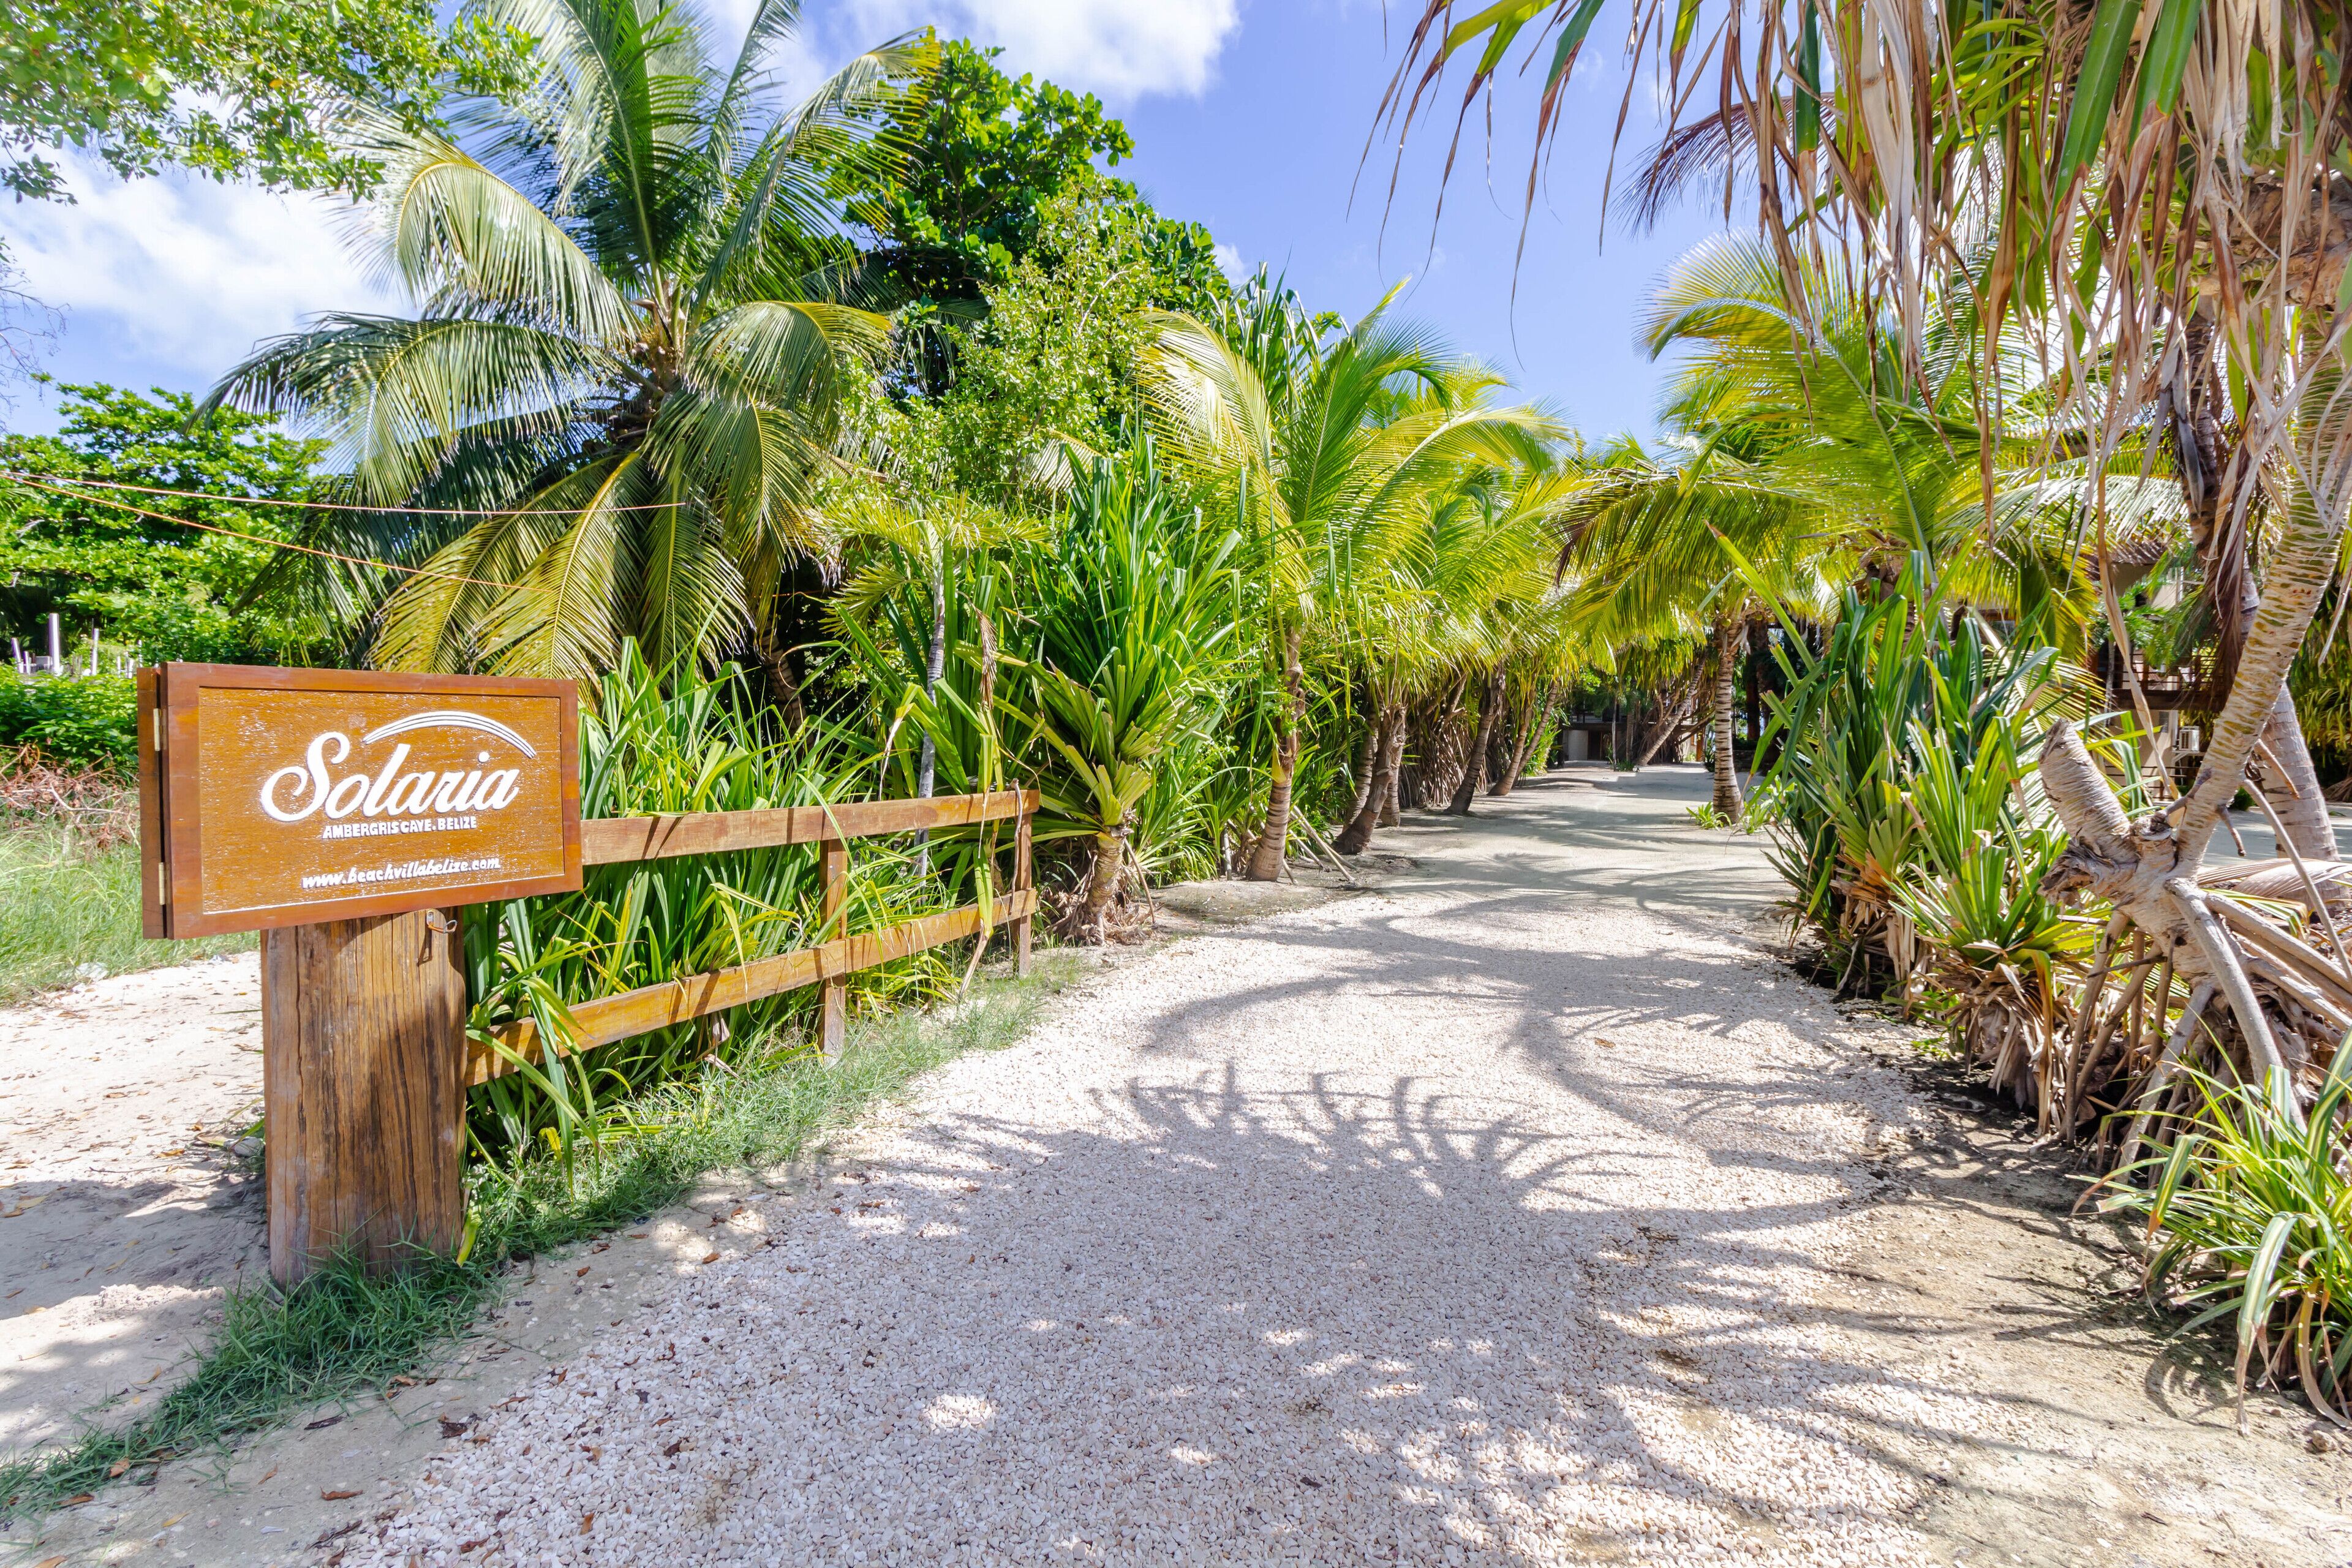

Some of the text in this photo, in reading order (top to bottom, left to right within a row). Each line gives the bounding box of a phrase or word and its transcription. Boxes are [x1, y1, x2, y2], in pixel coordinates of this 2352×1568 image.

[260, 731, 519, 822] Solaria
[322, 821, 399, 839] AMBERGRIS
[436, 816, 477, 831] BELIZE
[302, 858, 501, 888] www.beachvillabelize.com
